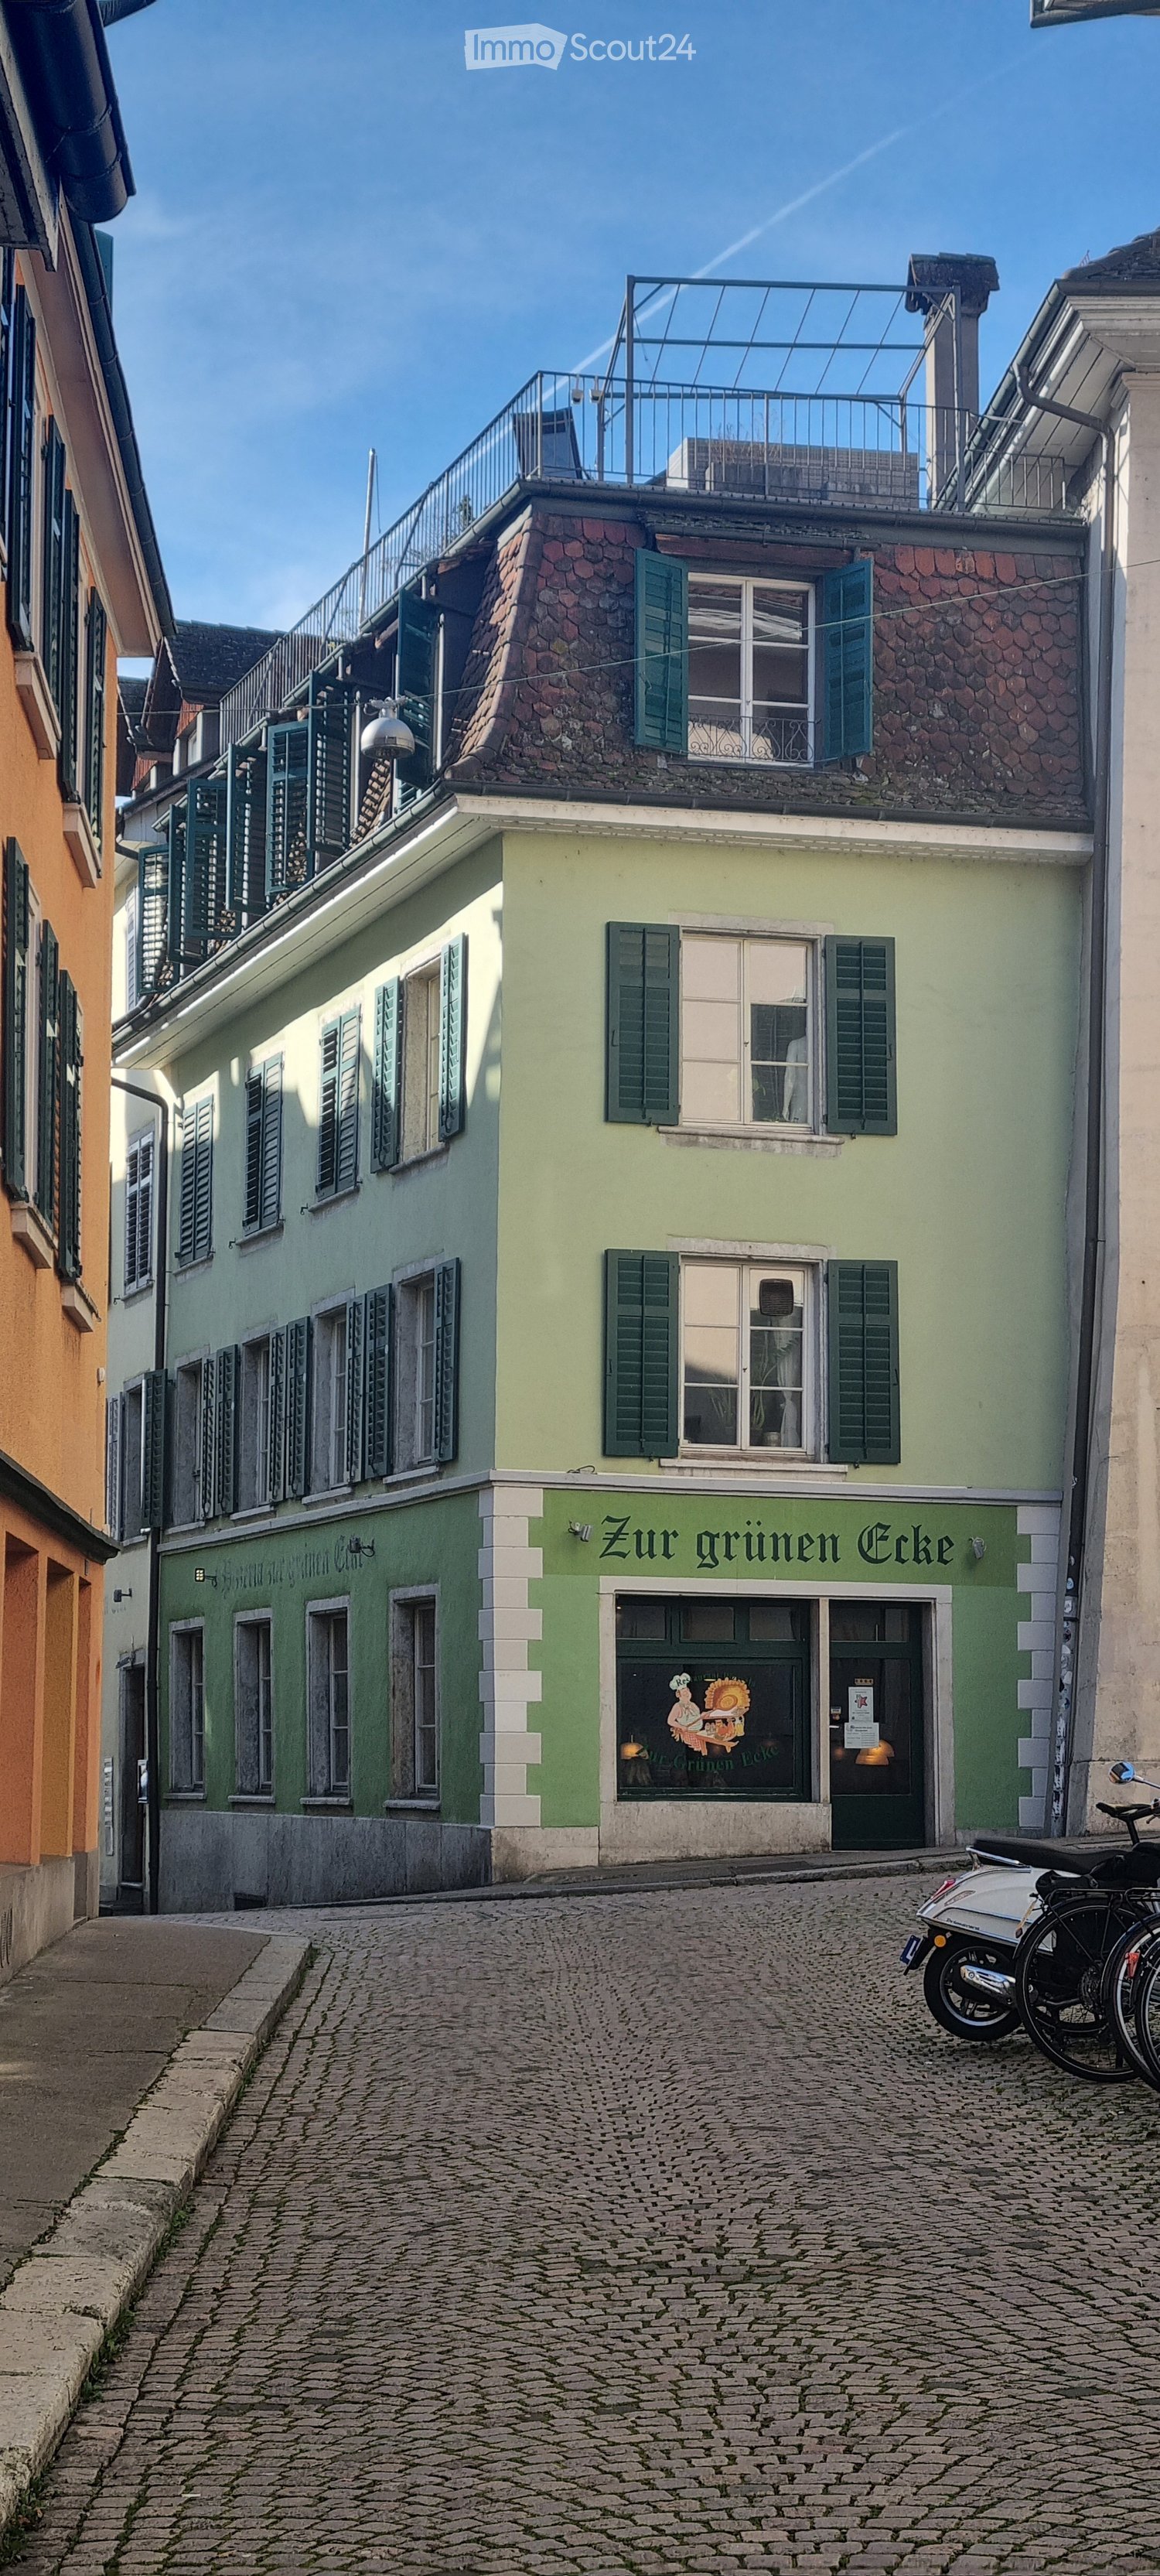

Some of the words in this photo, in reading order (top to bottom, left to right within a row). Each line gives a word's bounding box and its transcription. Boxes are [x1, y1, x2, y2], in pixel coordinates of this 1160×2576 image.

[599, 1515, 680, 1561] Zur
[697, 1520, 841, 1570] grünen
[857, 1522, 955, 1566] Ecke
